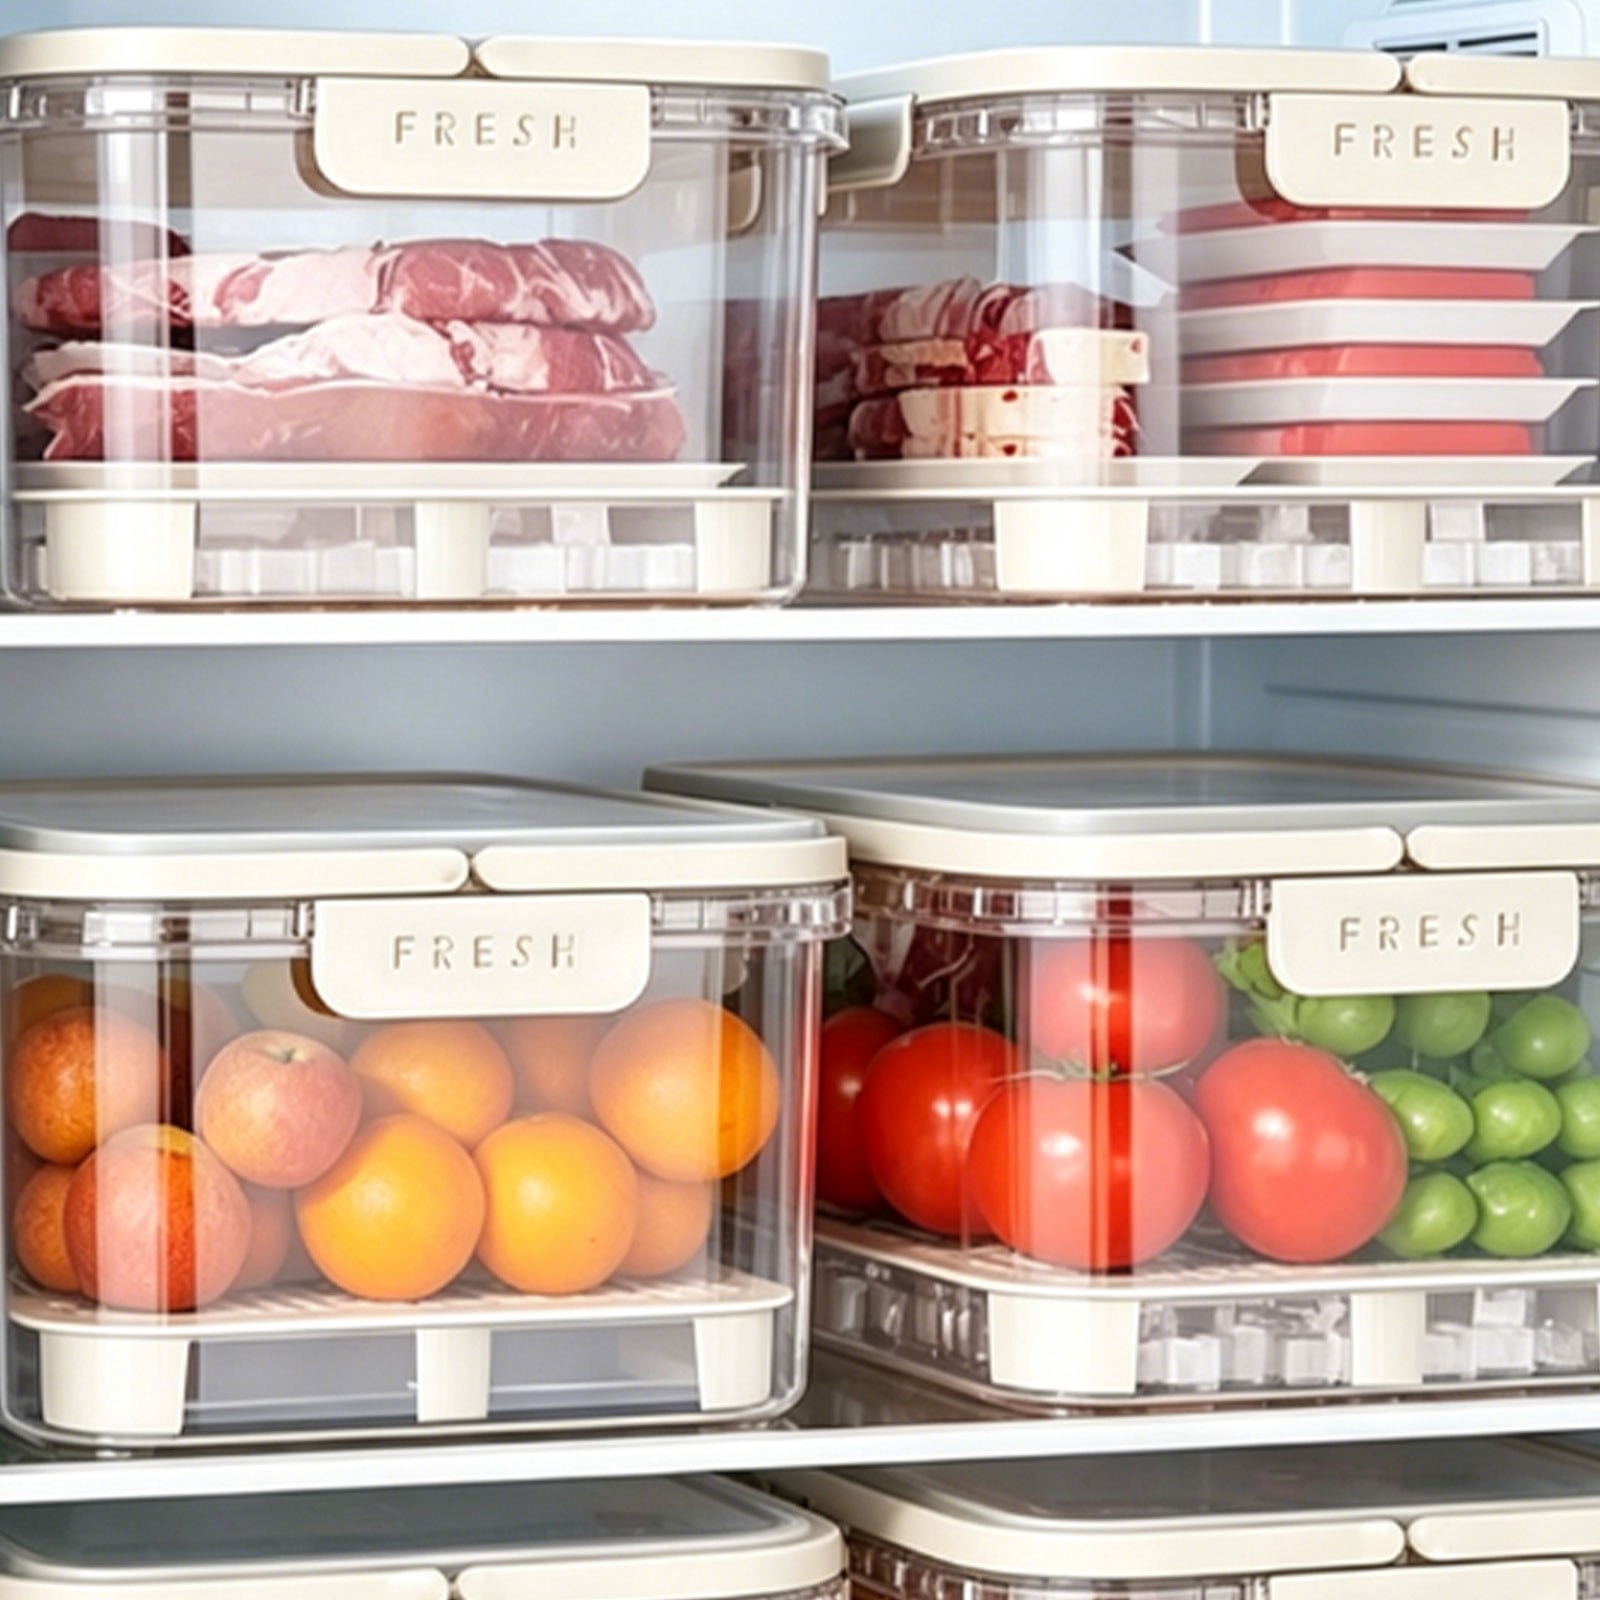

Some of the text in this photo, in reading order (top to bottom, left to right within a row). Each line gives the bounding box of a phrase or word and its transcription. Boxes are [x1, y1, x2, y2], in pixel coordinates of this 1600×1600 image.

[394, 110, 578, 149] FRESH
[1333, 122, 1516, 162] FRESH
[1339, 911, 1521, 951] FRESH
[393, 933, 576, 970] FRESH
